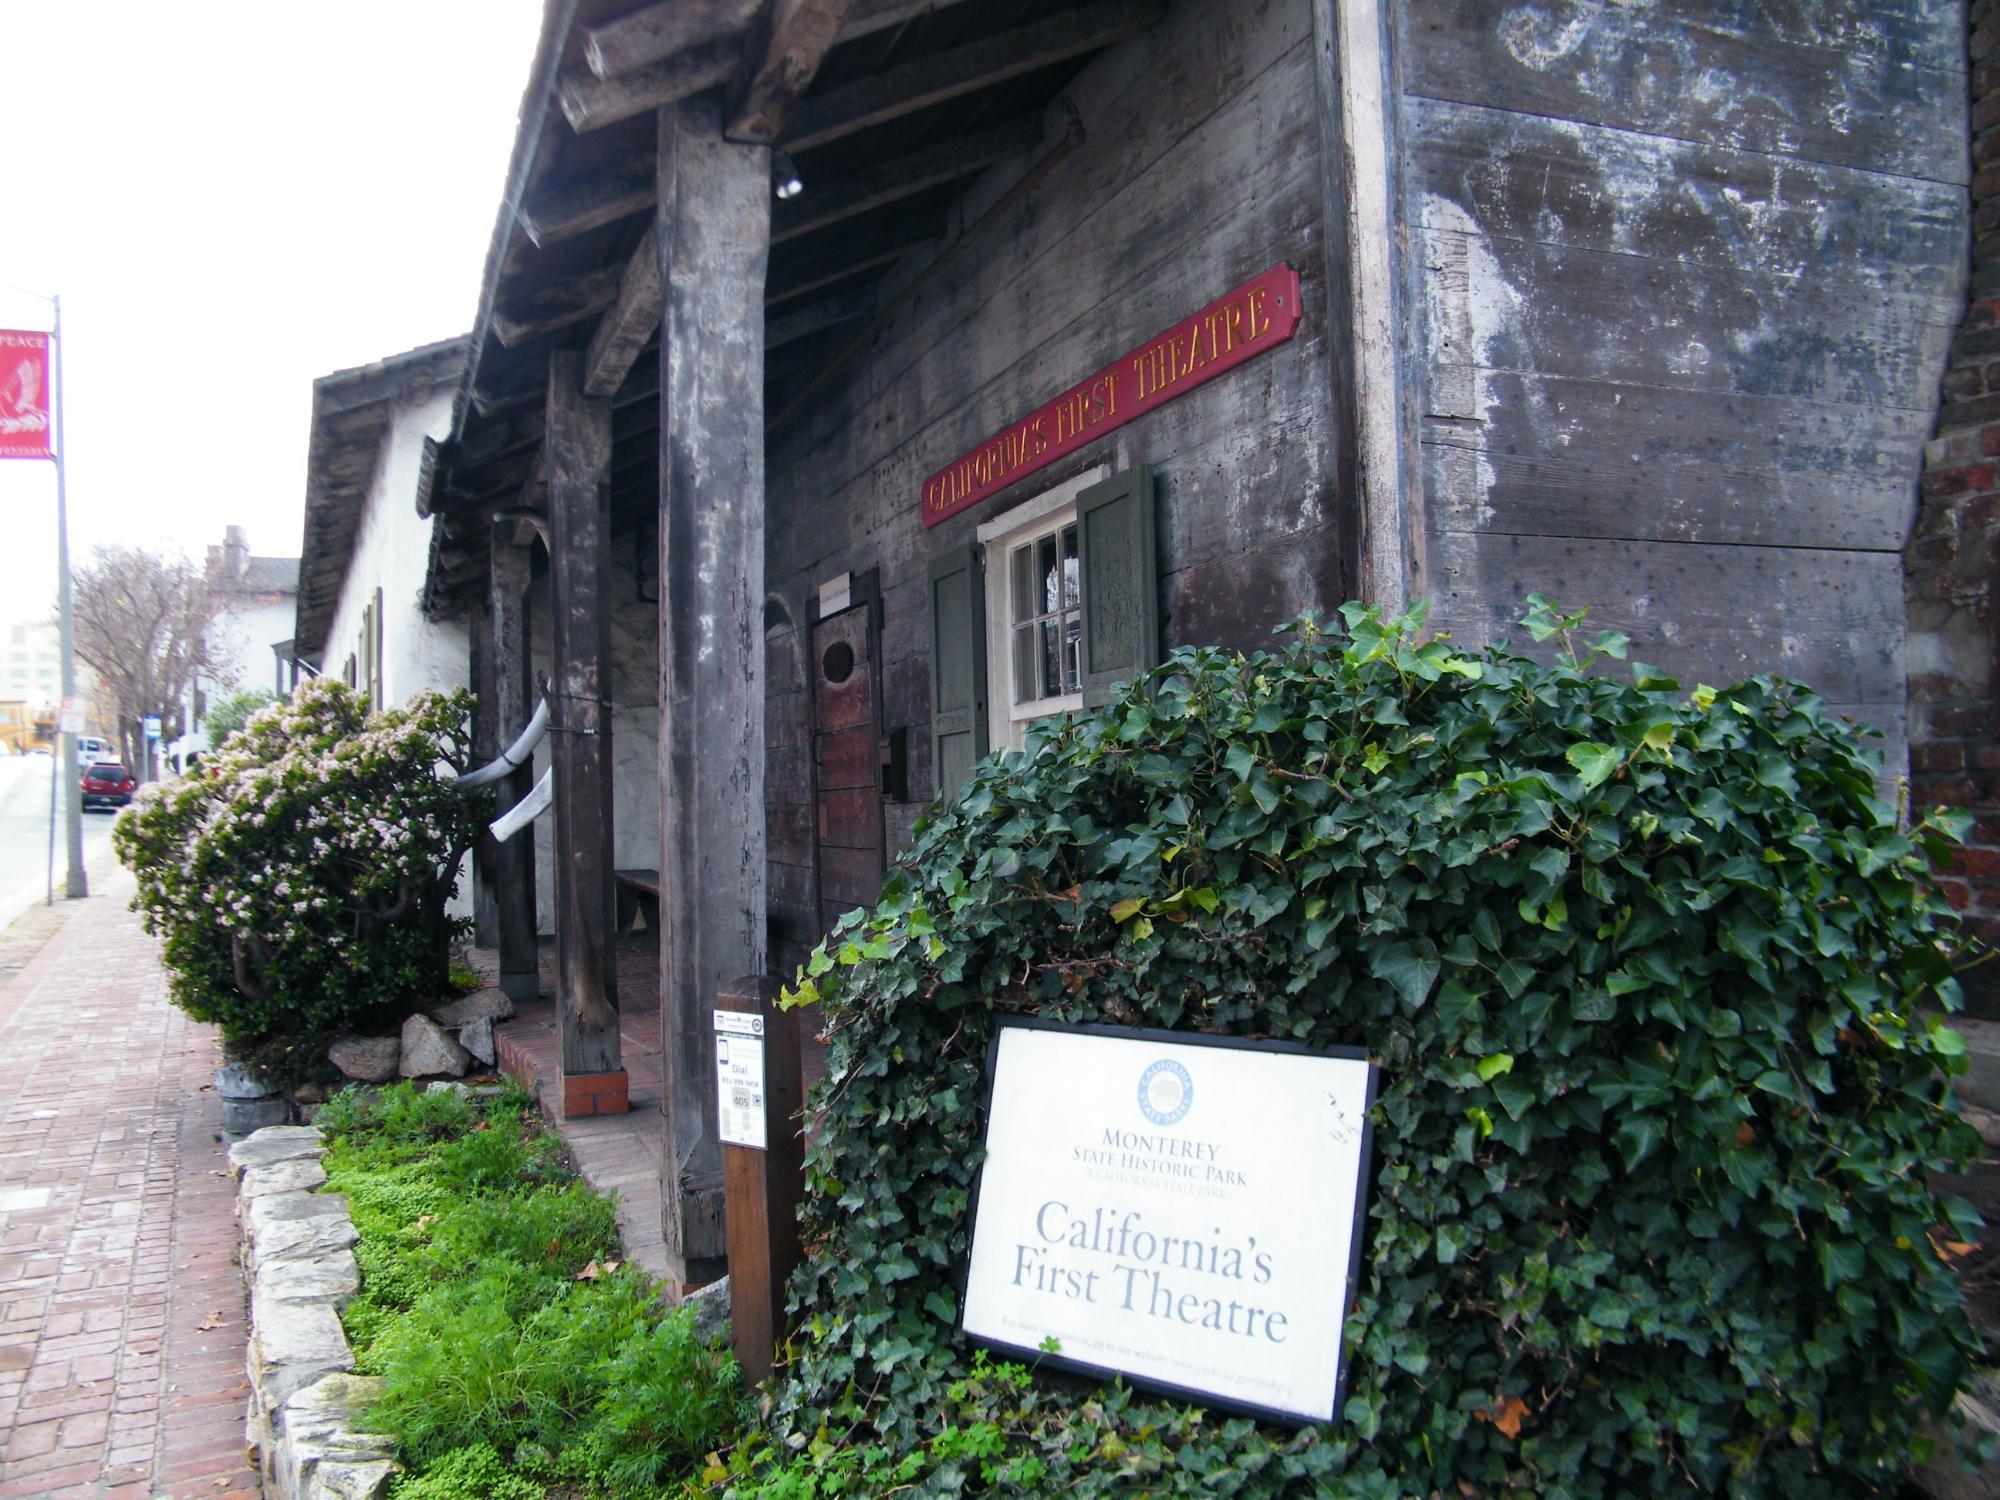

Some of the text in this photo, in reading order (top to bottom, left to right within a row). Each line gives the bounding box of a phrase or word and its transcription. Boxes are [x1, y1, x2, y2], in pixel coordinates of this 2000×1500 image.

[928, 287, 1271, 512] CALIFORNIA'S FIRST THEATRE
[732, 1064, 748, 1075] Dial
[1141, 1060, 1191, 1091] CALIFORNIA
[733, 1096, 749, 1108] 405
[1139, 1094, 1191, 1124] STATE PARKS
[1102, 1128, 1221, 1162] MONTEREY
[1071, 1145, 1249, 1187] STATE HISTORIC PARK
[1095, 1168, 1161, 1189] CALIFORNIA
[1164, 1180, 1196, 1195] STATE
[1198, 1185, 1227, 1200] PARK
[1036, 1200, 1274, 1285] California's
[1011, 1244, 1289, 1344] First Theatre
